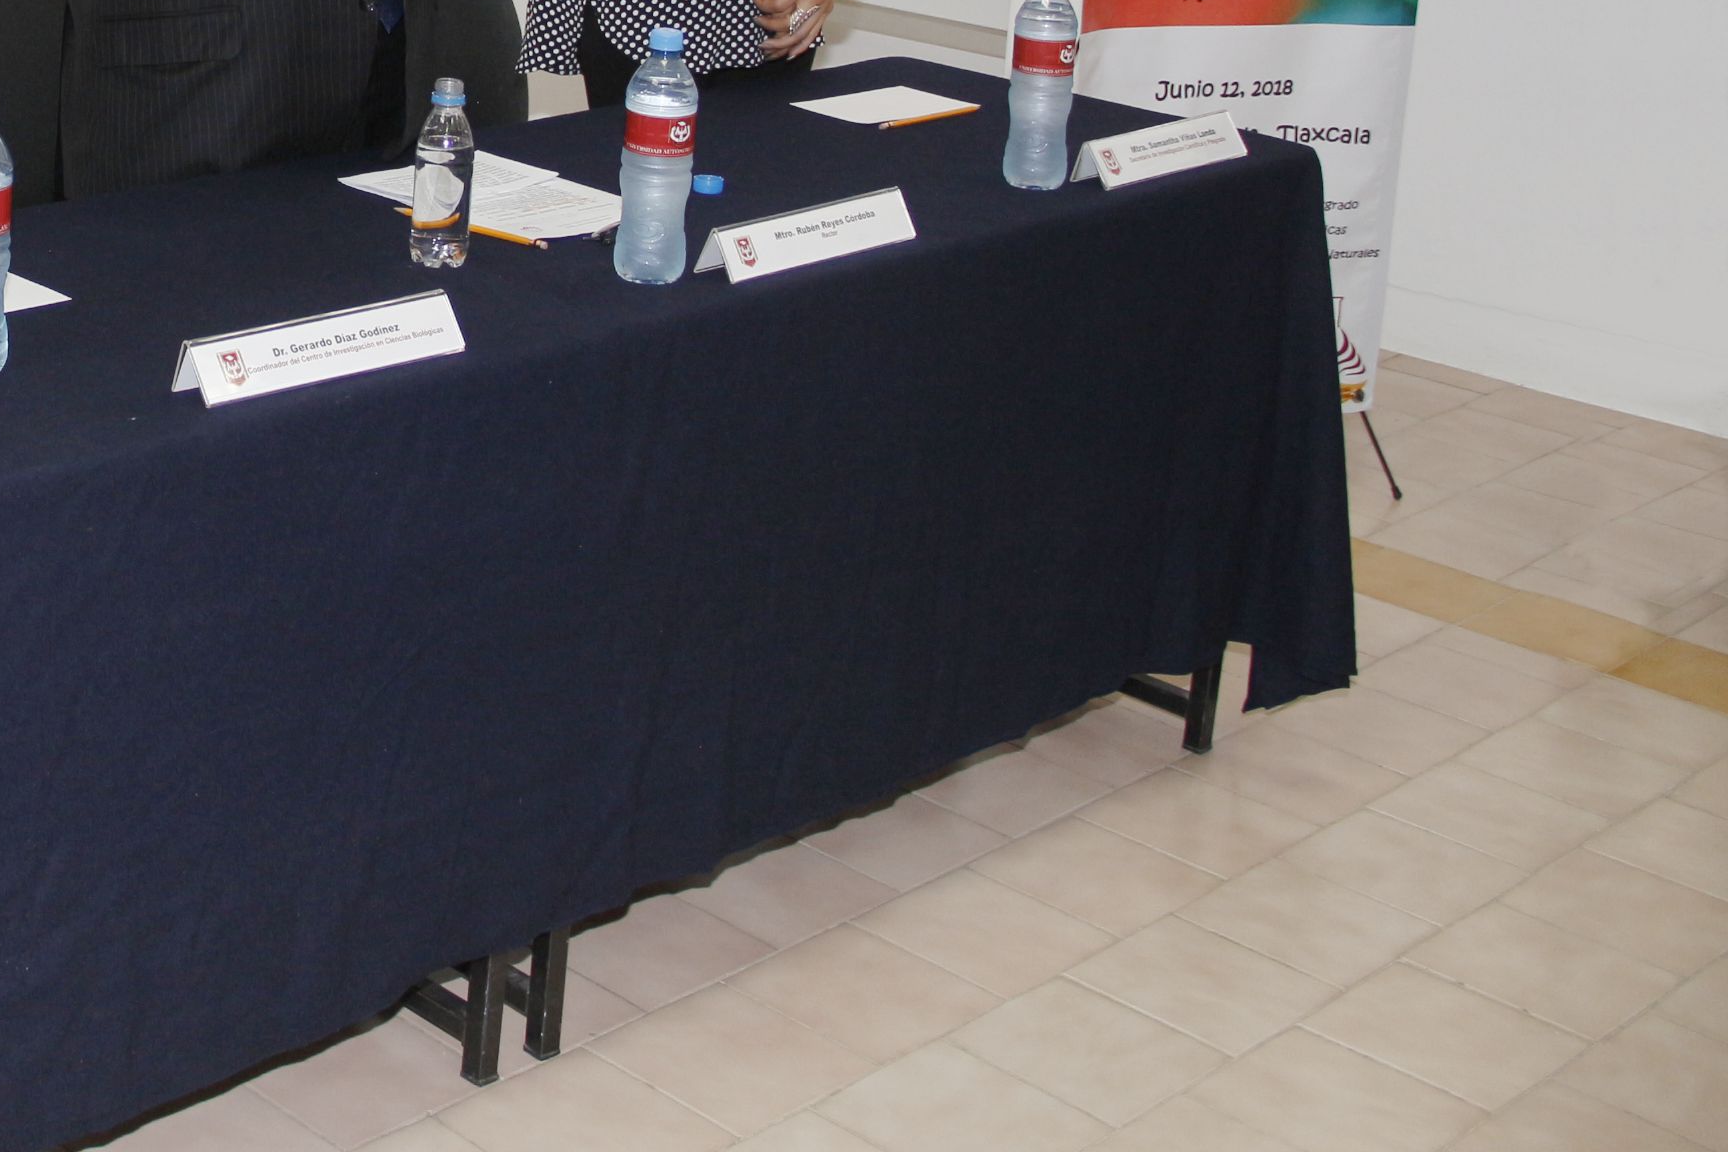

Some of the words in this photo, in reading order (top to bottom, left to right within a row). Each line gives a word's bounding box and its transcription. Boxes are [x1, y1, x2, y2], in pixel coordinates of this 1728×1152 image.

[1155, 80, 1214, 101] Junio
[1220, 81, 1245, 98] 12,
[1251, 79, 1293, 97] 2018
[1276, 125, 1371, 144] Tlaxcala
[1323, 200, 1359, 211] grado
[821, 218, 844, 229] Reyes
[247, 360, 289, 374] Coordinador
[289, 357, 301, 365] del
[301, 351, 324, 363] Centro
[324, 350, 332, 358] de
[385, 334, 411, 345] Ciencias
[272, 347, 289, 357] Dr.
[290, 338, 332, 354] Gerardo
